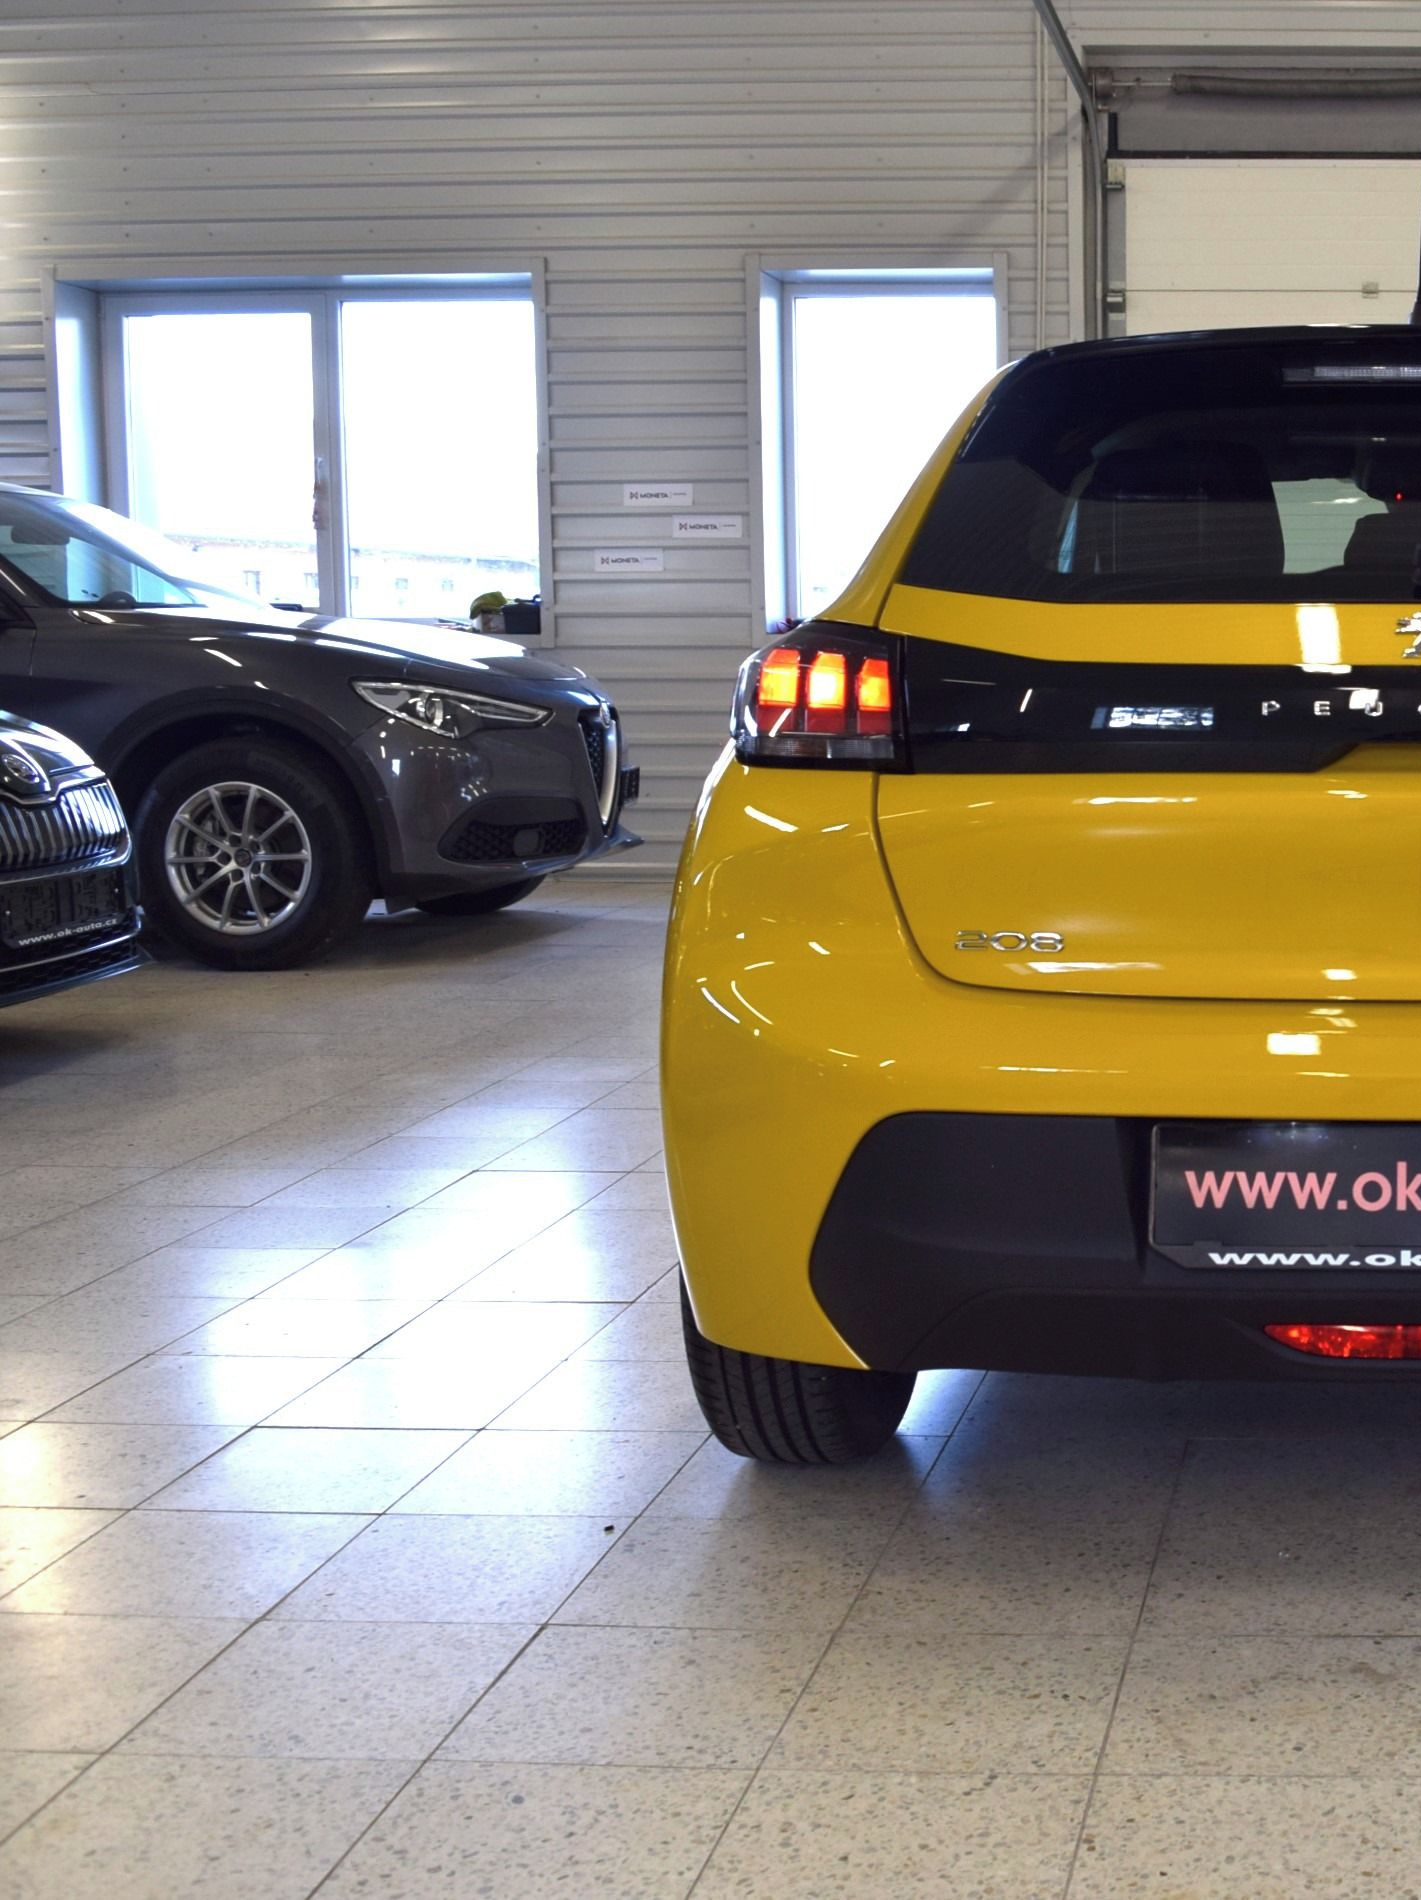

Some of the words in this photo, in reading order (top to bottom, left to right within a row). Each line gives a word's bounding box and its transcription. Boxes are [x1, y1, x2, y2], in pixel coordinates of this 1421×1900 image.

[688, 523, 718, 531] MONETA
[610, 556, 640, 564] MONETA
[18, 918, 118, 946] www.ok-auta.cz
[955, 930, 1064, 952] 208
